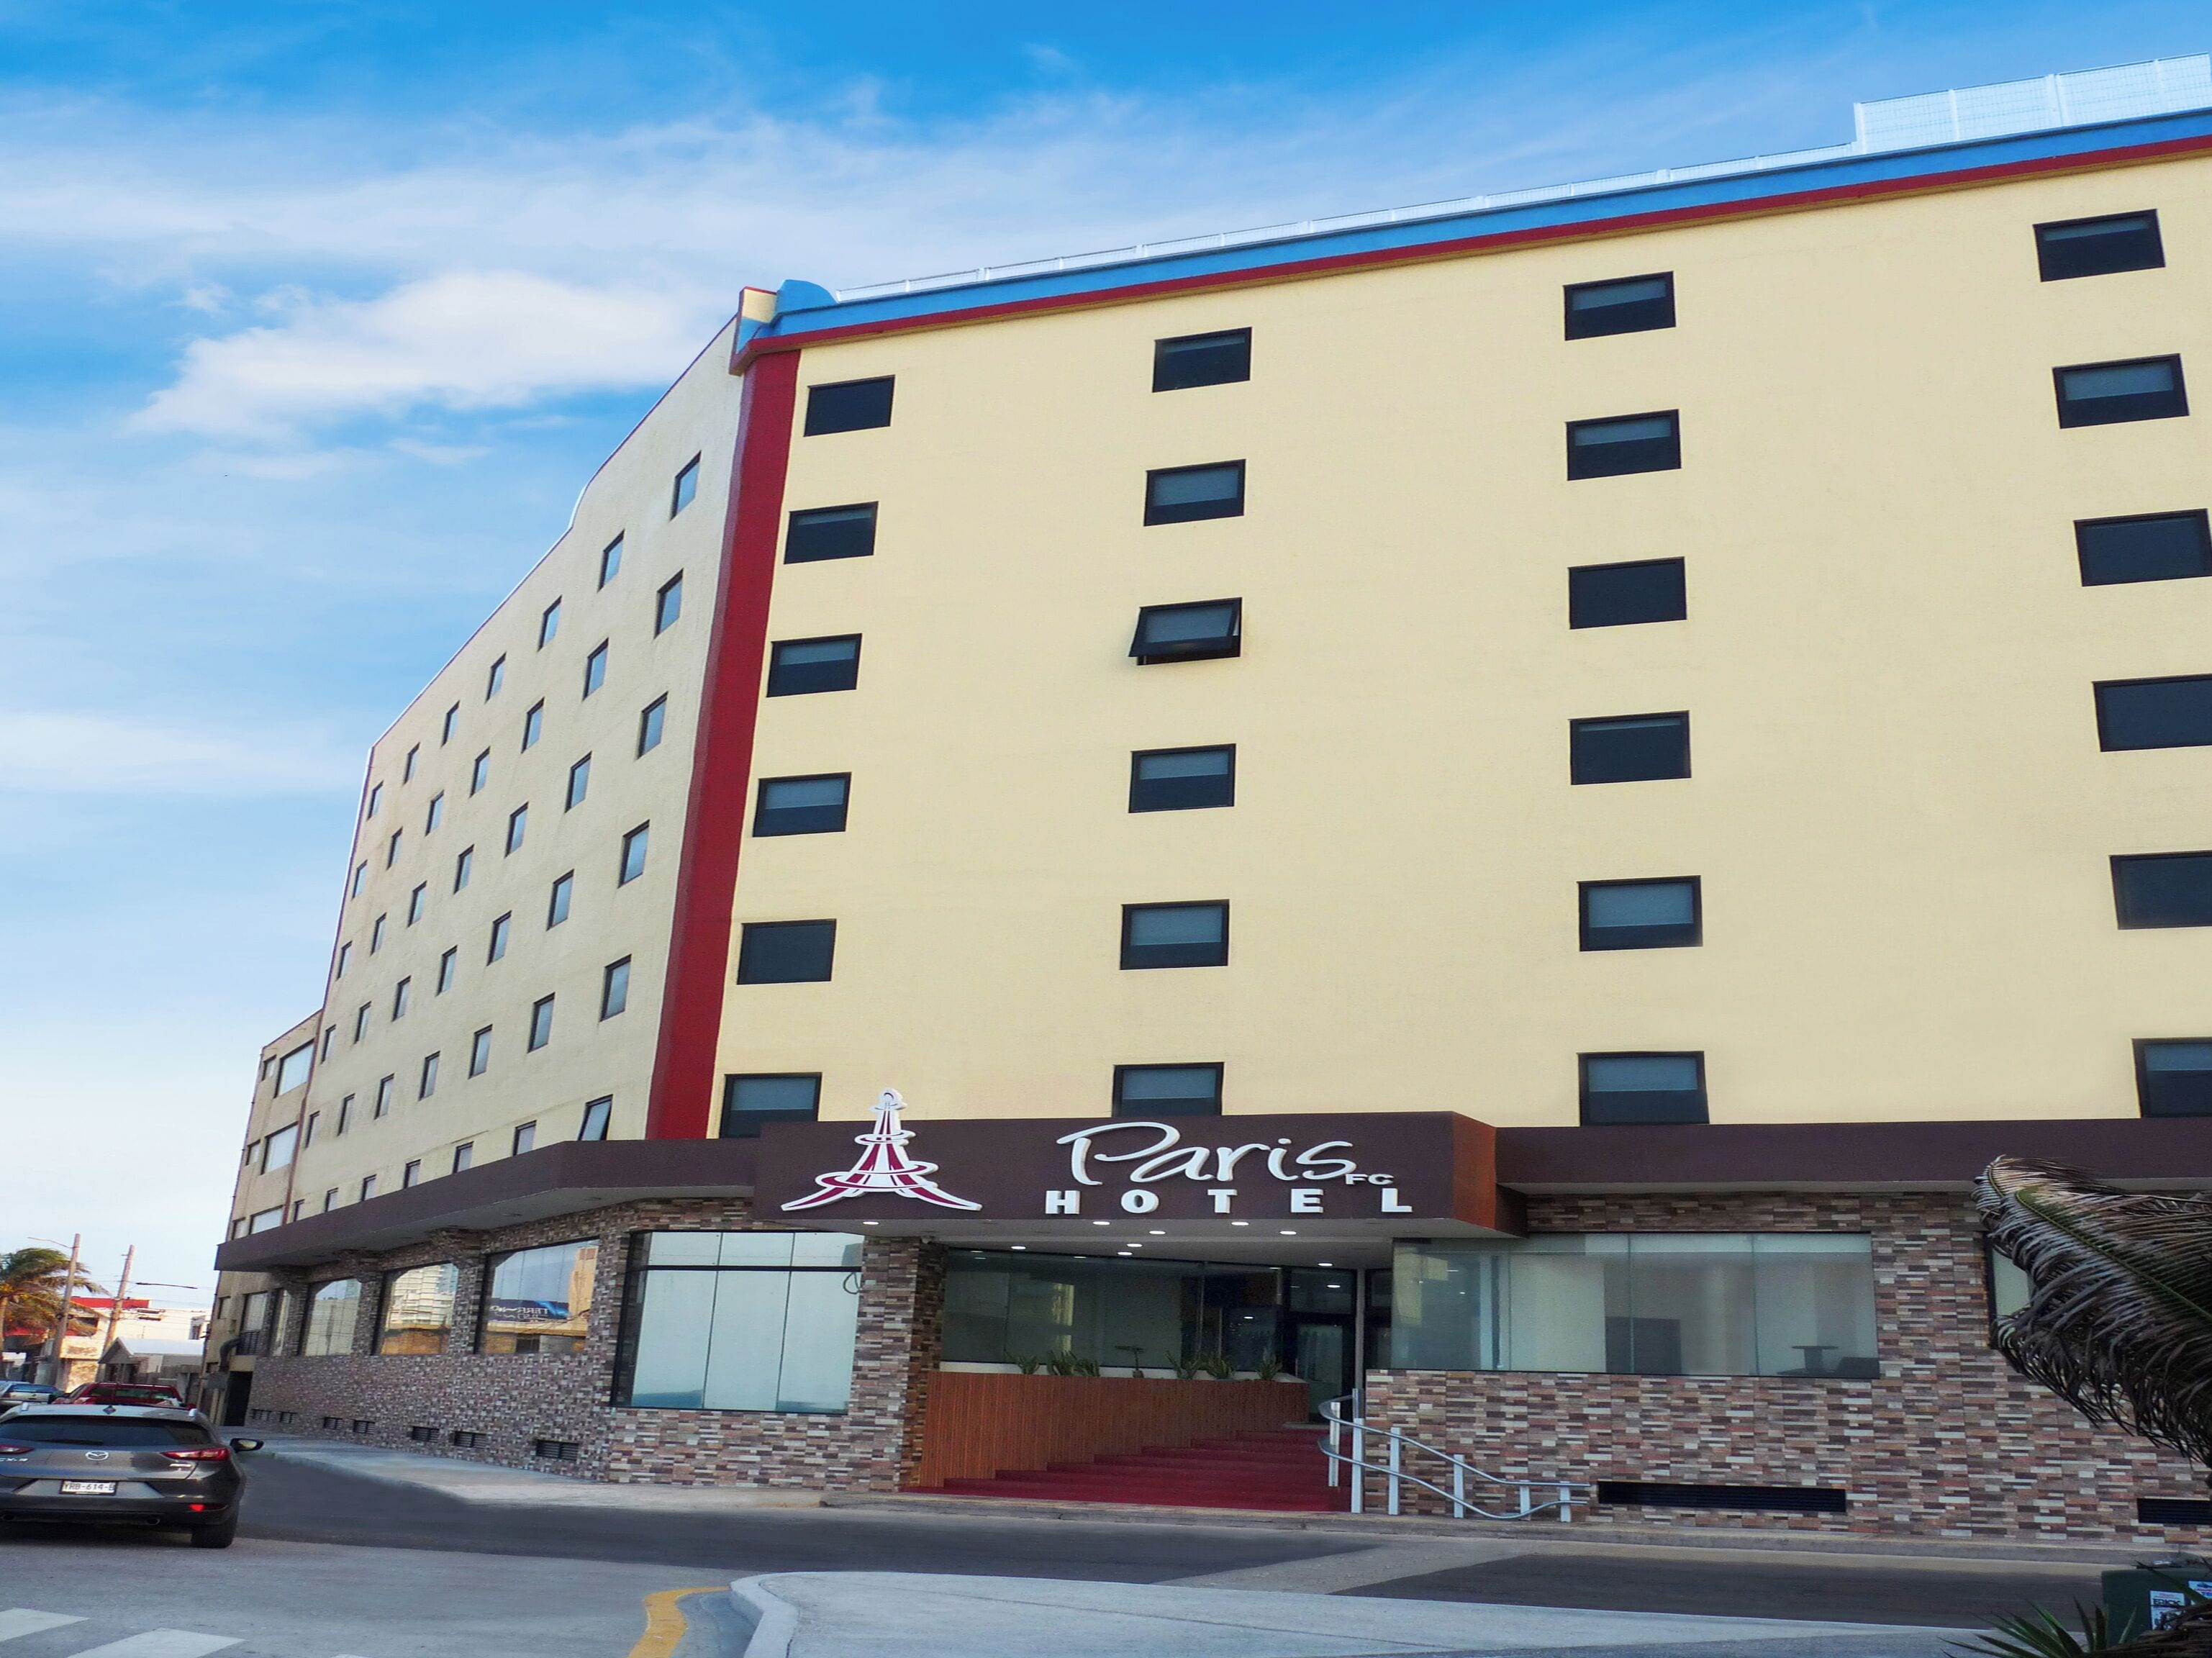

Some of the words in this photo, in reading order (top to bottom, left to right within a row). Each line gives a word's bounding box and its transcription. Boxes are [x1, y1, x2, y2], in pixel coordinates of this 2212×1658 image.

[1056, 1121, 1358, 1186] Paris
[1346, 1173, 1395, 1186] FC
[1045, 1187, 1413, 1214] HOTEL
